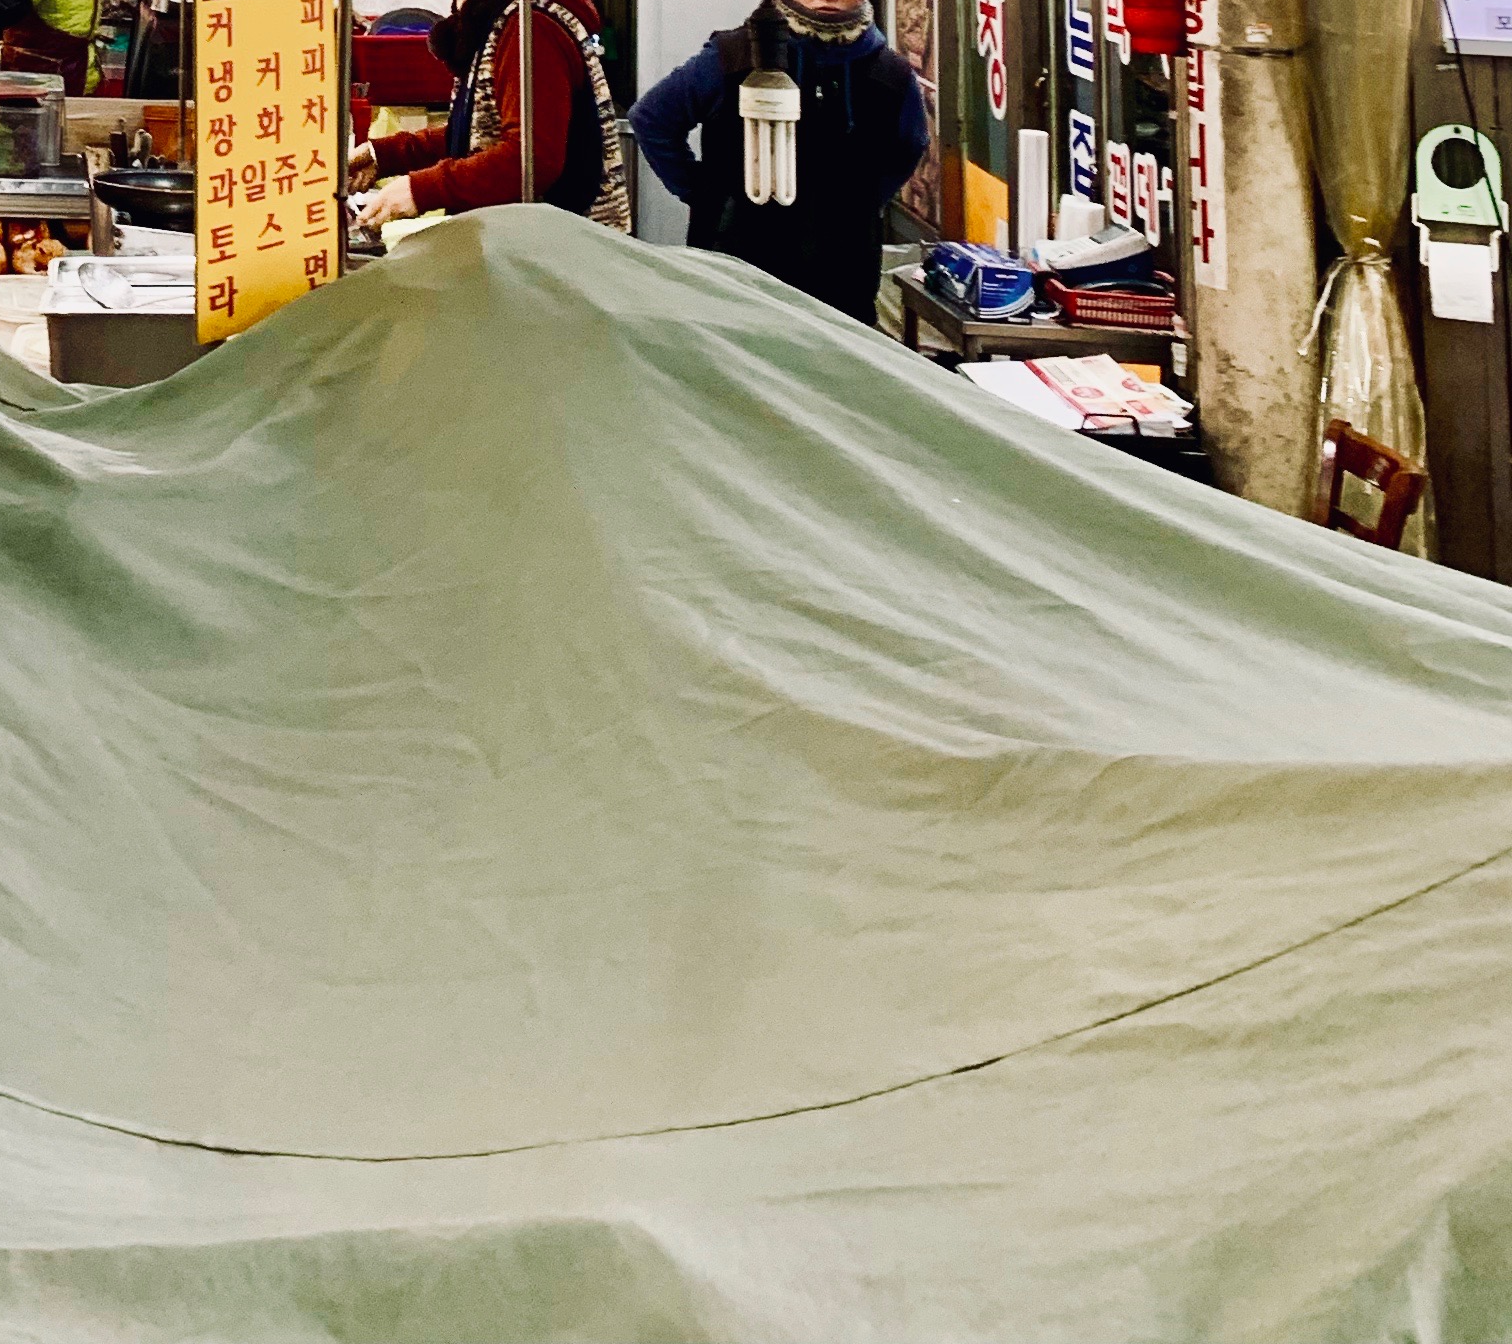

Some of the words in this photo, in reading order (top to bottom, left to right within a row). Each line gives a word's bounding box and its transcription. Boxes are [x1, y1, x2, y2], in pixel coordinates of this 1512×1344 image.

[208, 43, 327, 104] 냉커피
[208, 94, 329, 158] 쌍화차
[208, 149, 330, 209] 과일쥬스
[208, 199, 330, 266] 토스트
[208, 249, 329, 318] 라면
